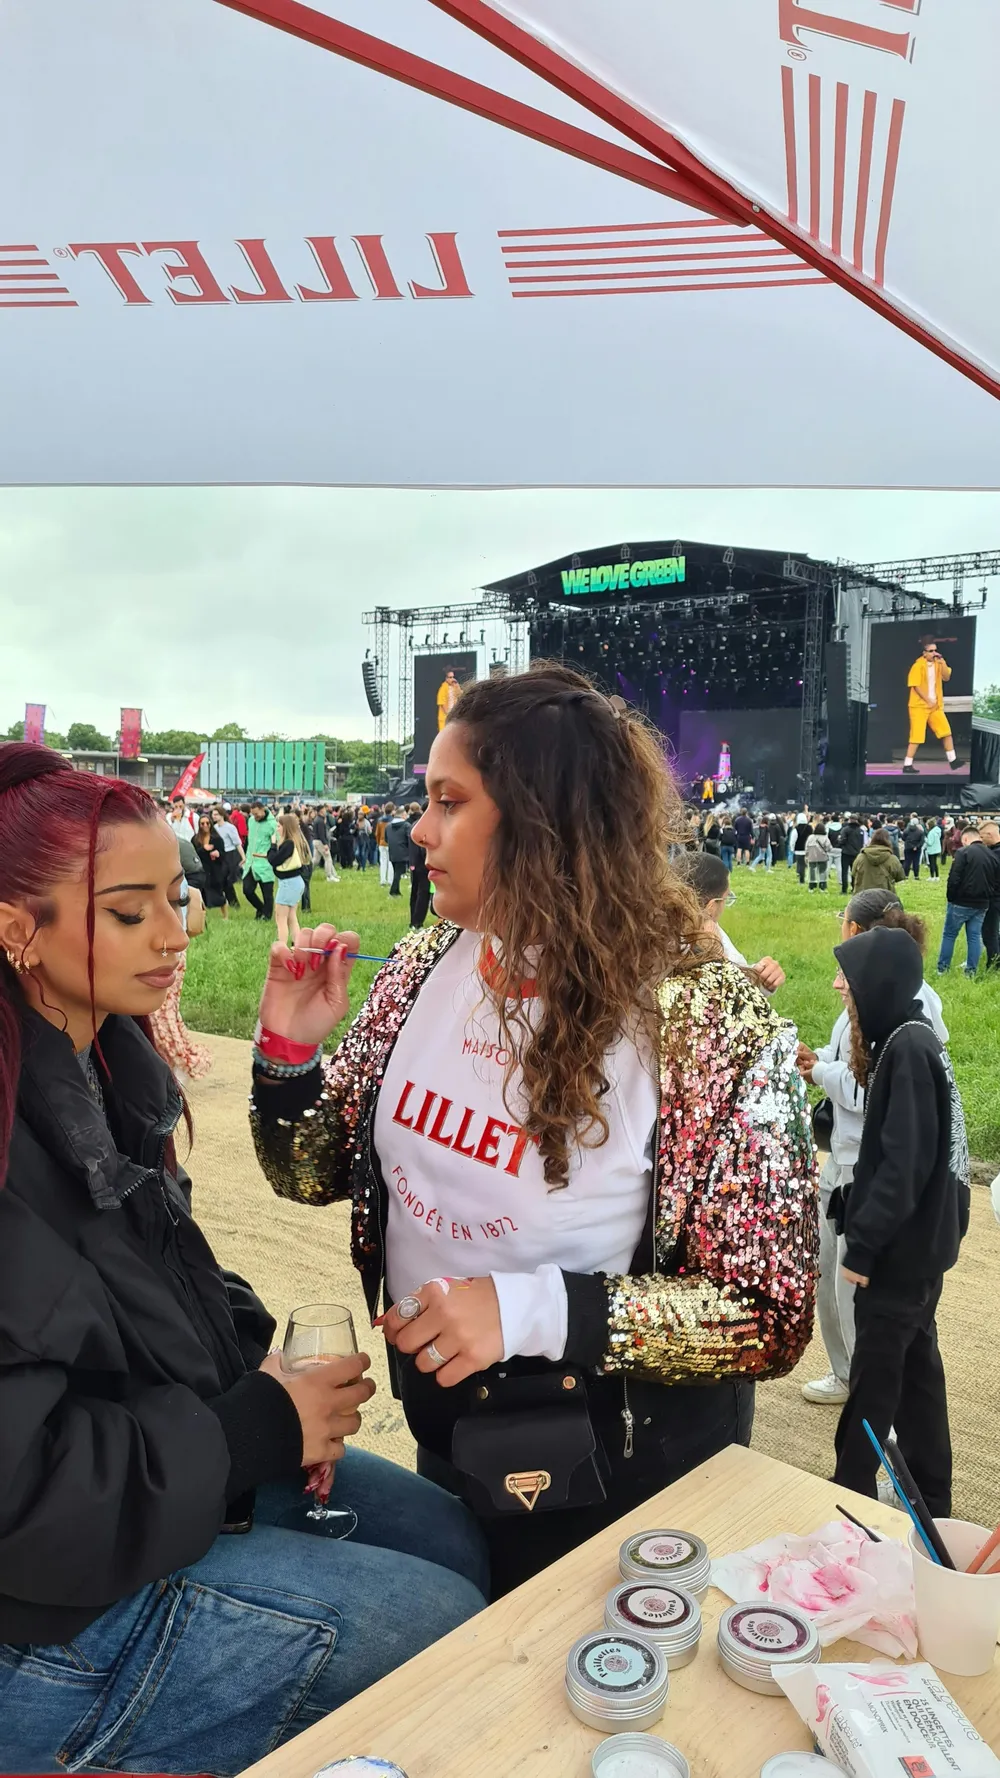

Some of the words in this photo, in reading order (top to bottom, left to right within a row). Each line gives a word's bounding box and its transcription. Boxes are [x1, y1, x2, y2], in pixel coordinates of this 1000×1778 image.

[462, 1037, 513, 1065] MAISO
[392, 1080, 543, 1178] LILLET
[392, 1164, 444, 1234] FONDÉE
[451, 1222, 473, 1241] EN
[480, 1216, 519, 1239] 1872
[642, 1599, 677, 1618] Paillettes
[746, 1620, 783, 1644] Paillettes
[593, 1647, 622, 1678] Paillettes
[903, 1699, 914, 1710] EN
[912, 1699, 924, 1713] QUI
[925, 1707, 955, 1748] LINGETTES
